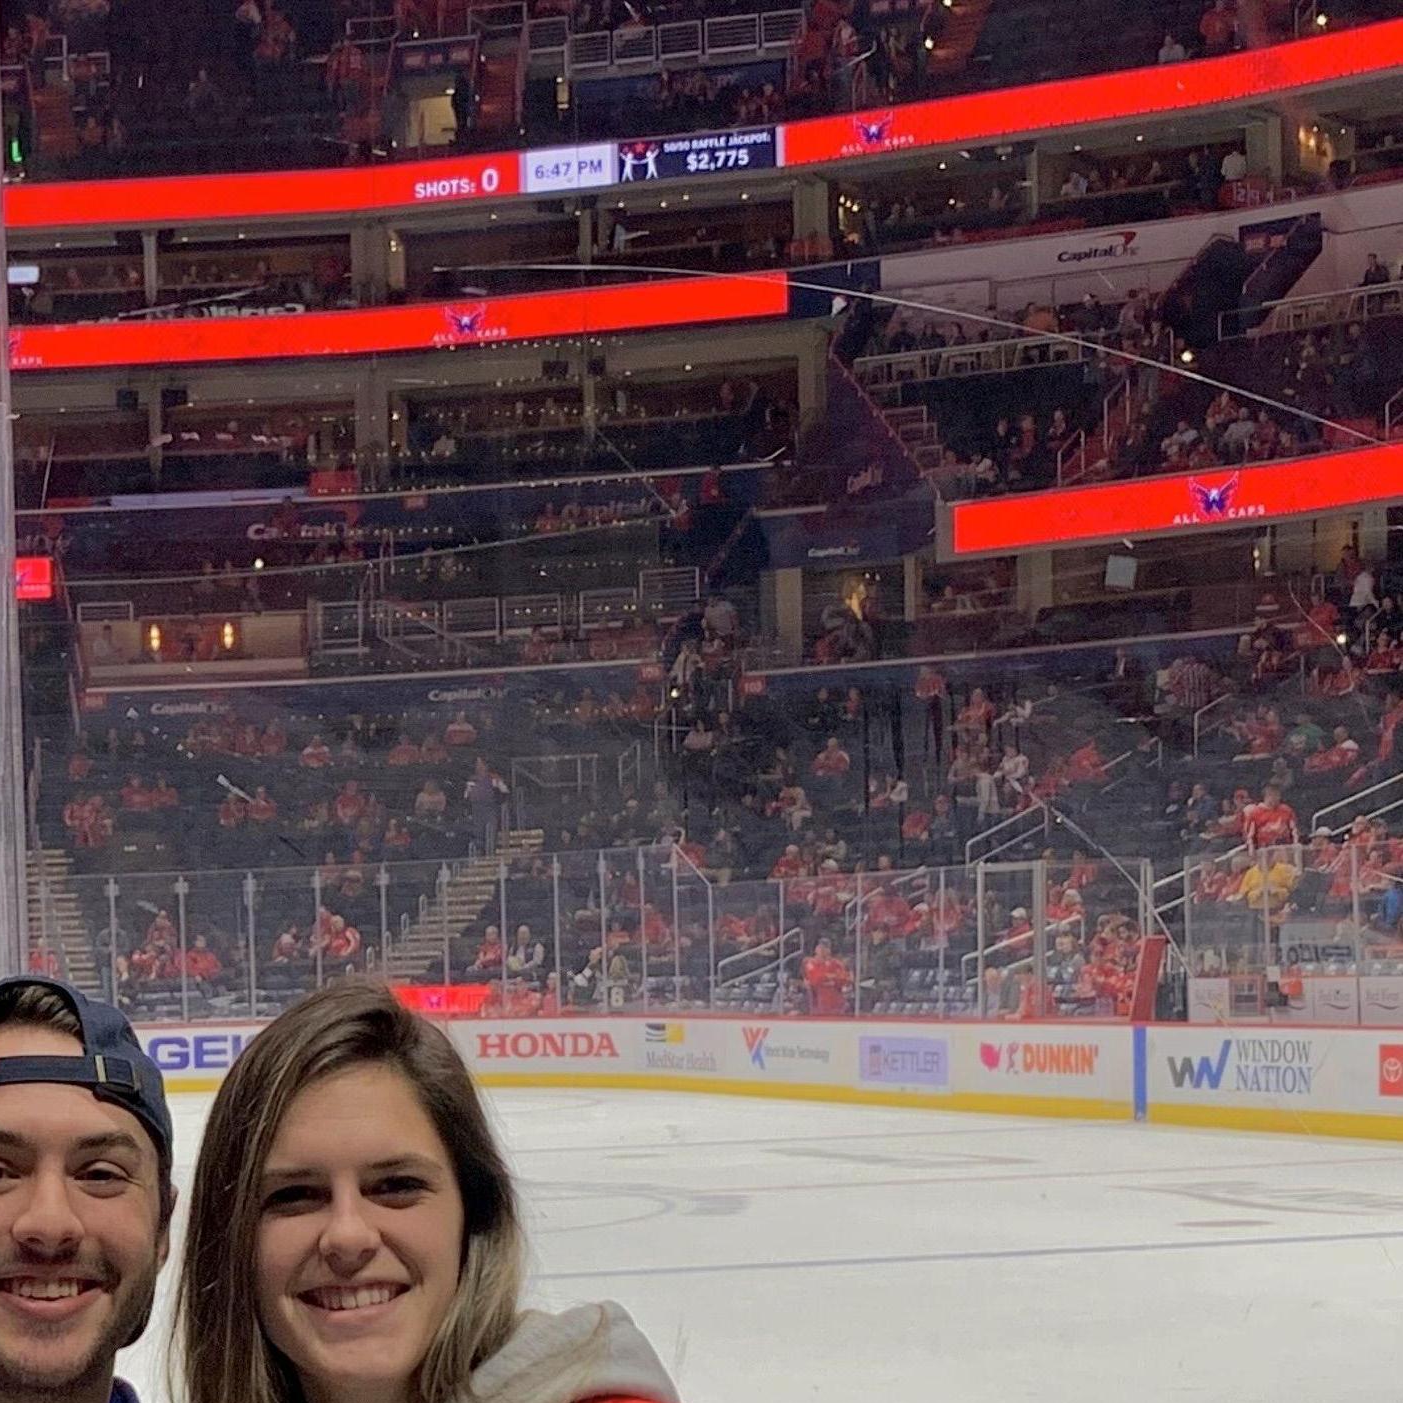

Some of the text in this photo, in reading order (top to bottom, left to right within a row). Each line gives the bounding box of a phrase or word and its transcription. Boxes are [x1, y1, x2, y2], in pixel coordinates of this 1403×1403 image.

[691, 136, 727, 150] RAFFLE
[534, 158, 603, 180] 6:47 PM
[686, 149, 749, 172] $2,775
[414, 168, 499, 199] SHOTS: 0
[1172, 504, 1266, 525] ALL CAPS
[147, 1033, 242, 1071] GEI
[476, 1031, 620, 1058] HONDA
[1235, 1038, 1313, 1064] WINDOW
[686, 1052, 717, 1072] Health
[883, 1049, 942, 1074] KETTLER
[1022, 1041, 1099, 1076] DUNKIN'
[1235, 1063, 1314, 1094] NATION
